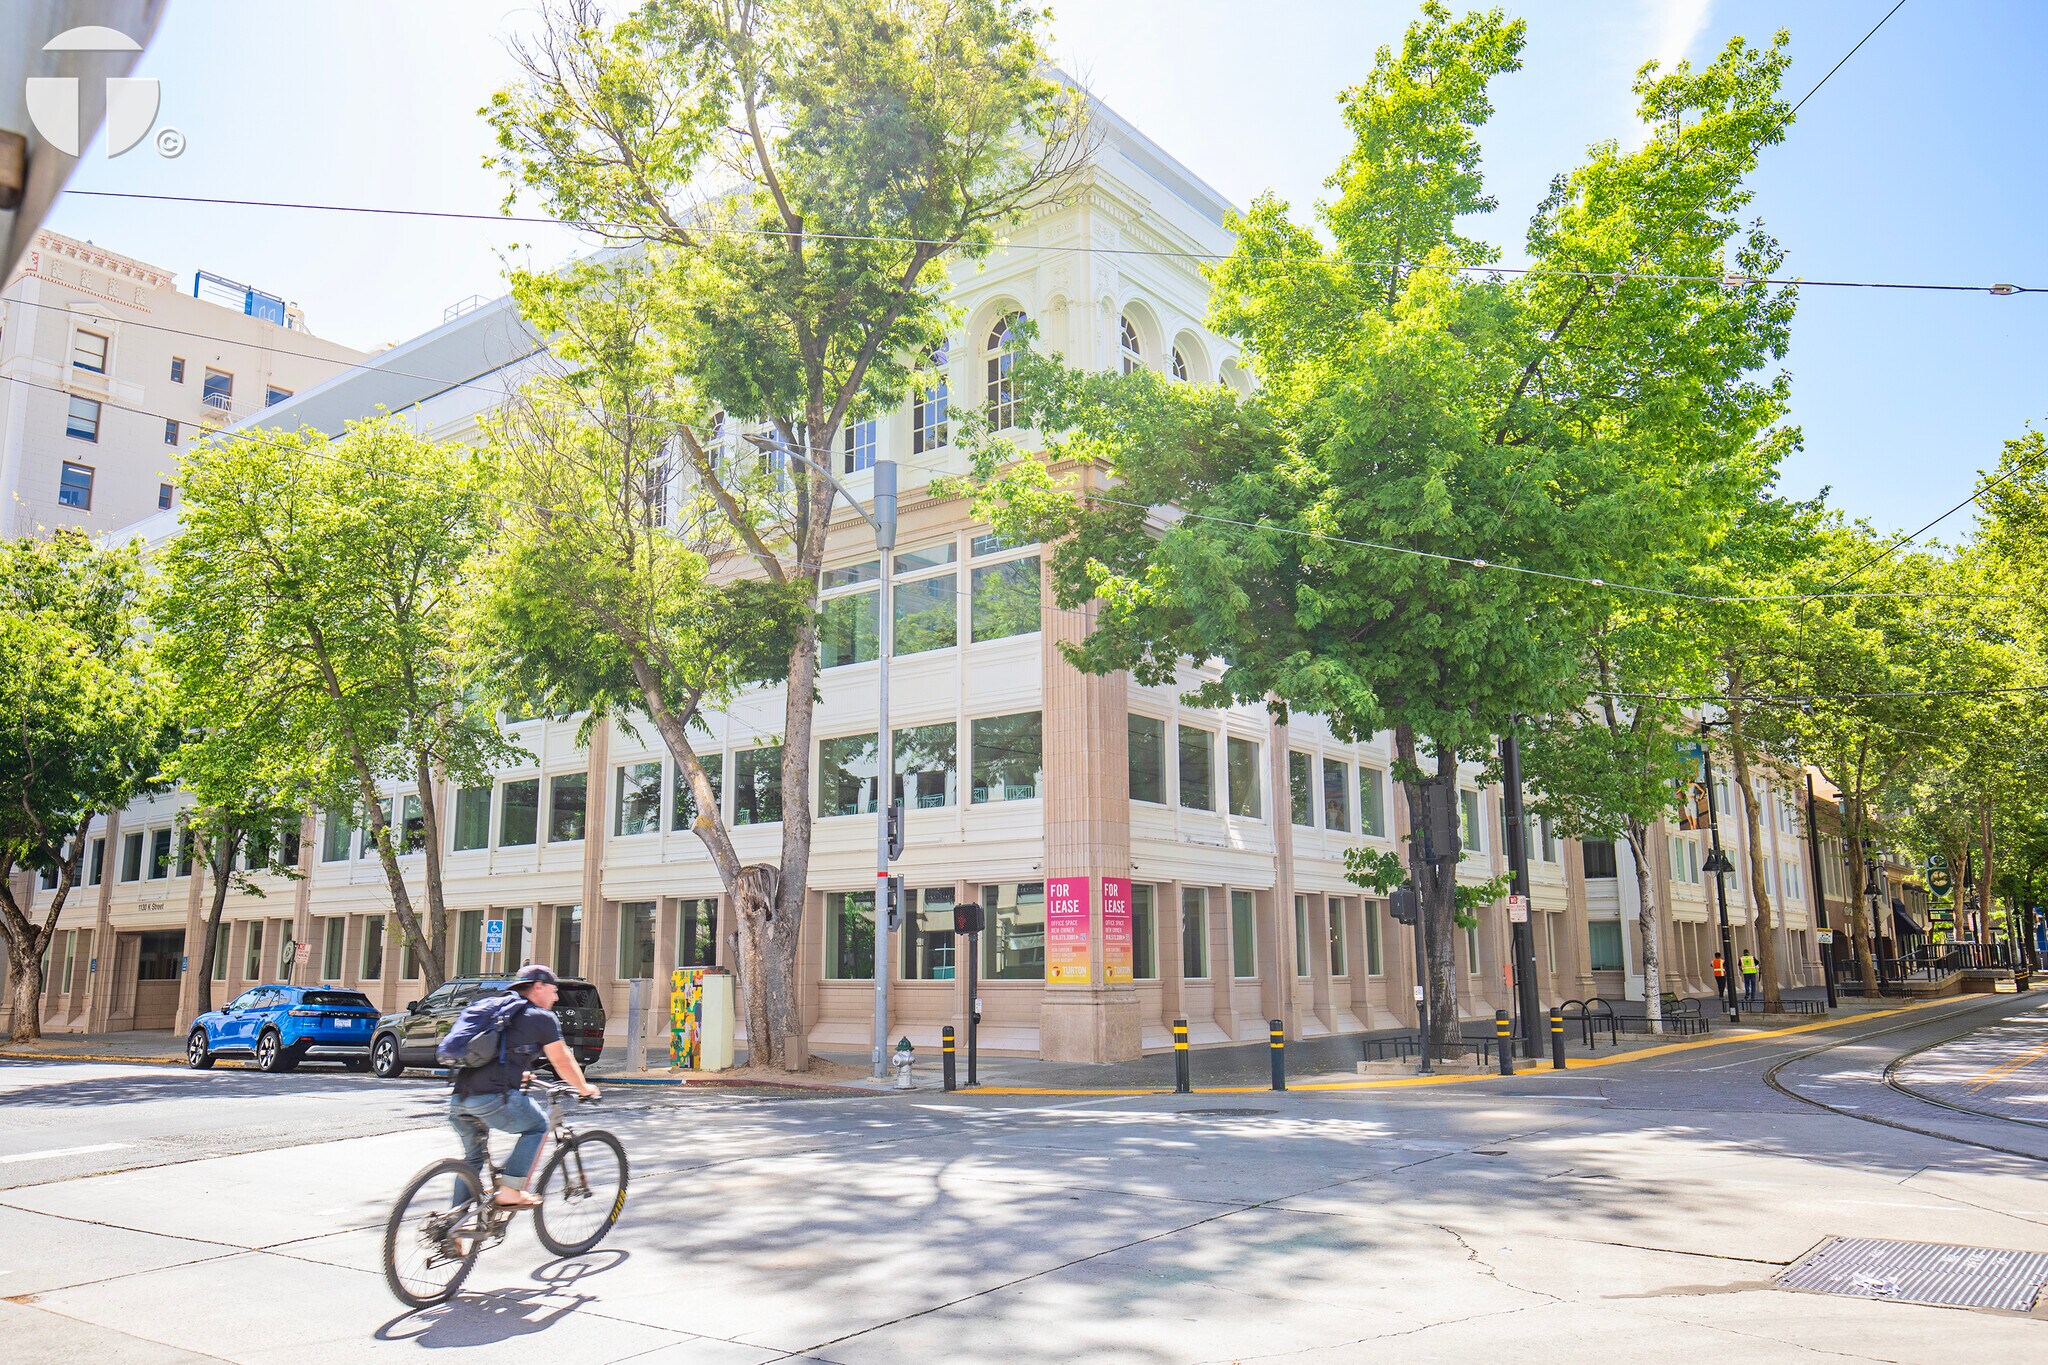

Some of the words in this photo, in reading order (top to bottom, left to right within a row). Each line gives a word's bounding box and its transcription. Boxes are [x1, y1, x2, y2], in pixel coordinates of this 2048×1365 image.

[1050, 884, 1069, 897] FOR
[1104, 883, 1118, 896] FOR
[1050, 900, 1079, 913] LEASE
[1104, 899, 1125, 913] LEASE
[1062, 966, 1086, 975] TURTON
